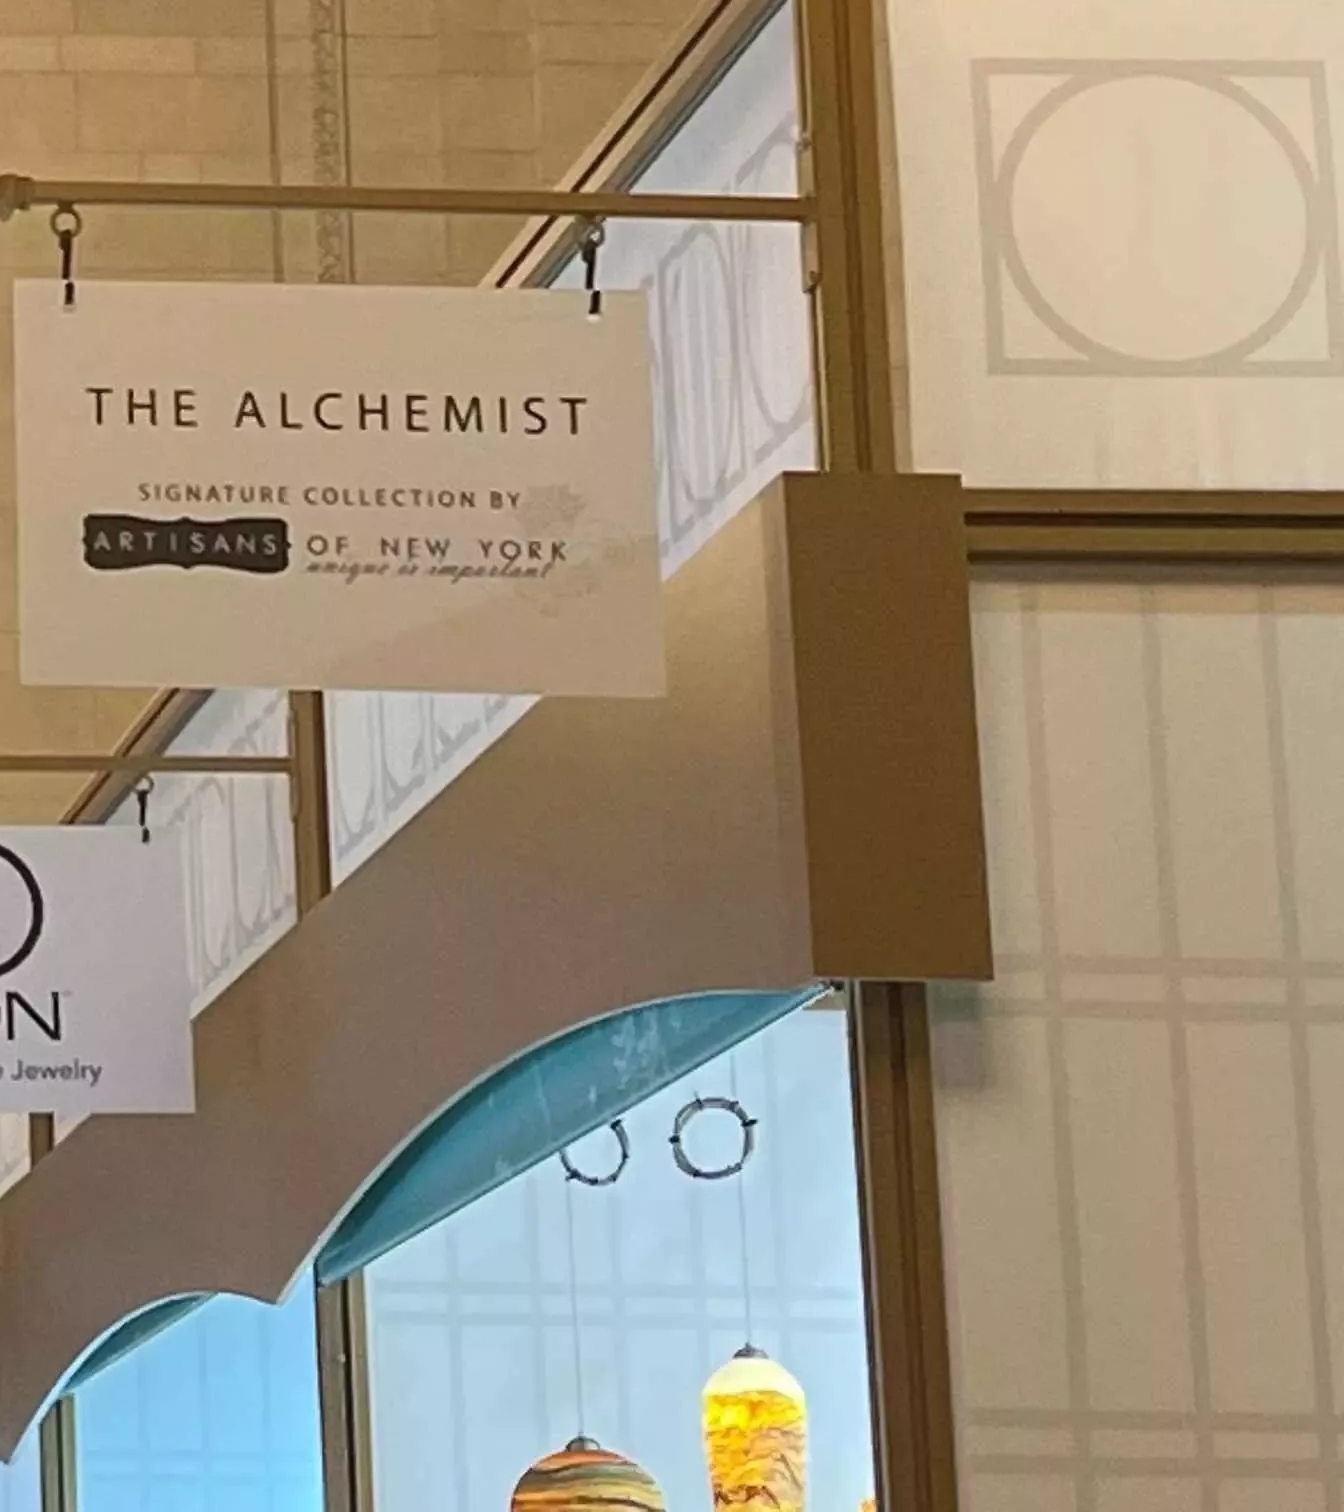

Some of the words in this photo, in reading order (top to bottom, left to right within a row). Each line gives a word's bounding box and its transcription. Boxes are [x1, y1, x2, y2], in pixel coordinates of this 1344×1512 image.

[85, 386, 200, 429] THE
[233, 390, 591, 437] ALCHEMIST
[137, 483, 291, 505] SIGNATURE
[303, 486, 477, 509] COLLECTION
[489, 489, 522, 510] BY
[92, 529, 279, 557] ARTISANS
[306, 534, 351, 557] OF
[380, 535, 451, 561] NEW
[477, 539, 568, 563] YORK
[10, 1057, 103, 1088] Jewelry
